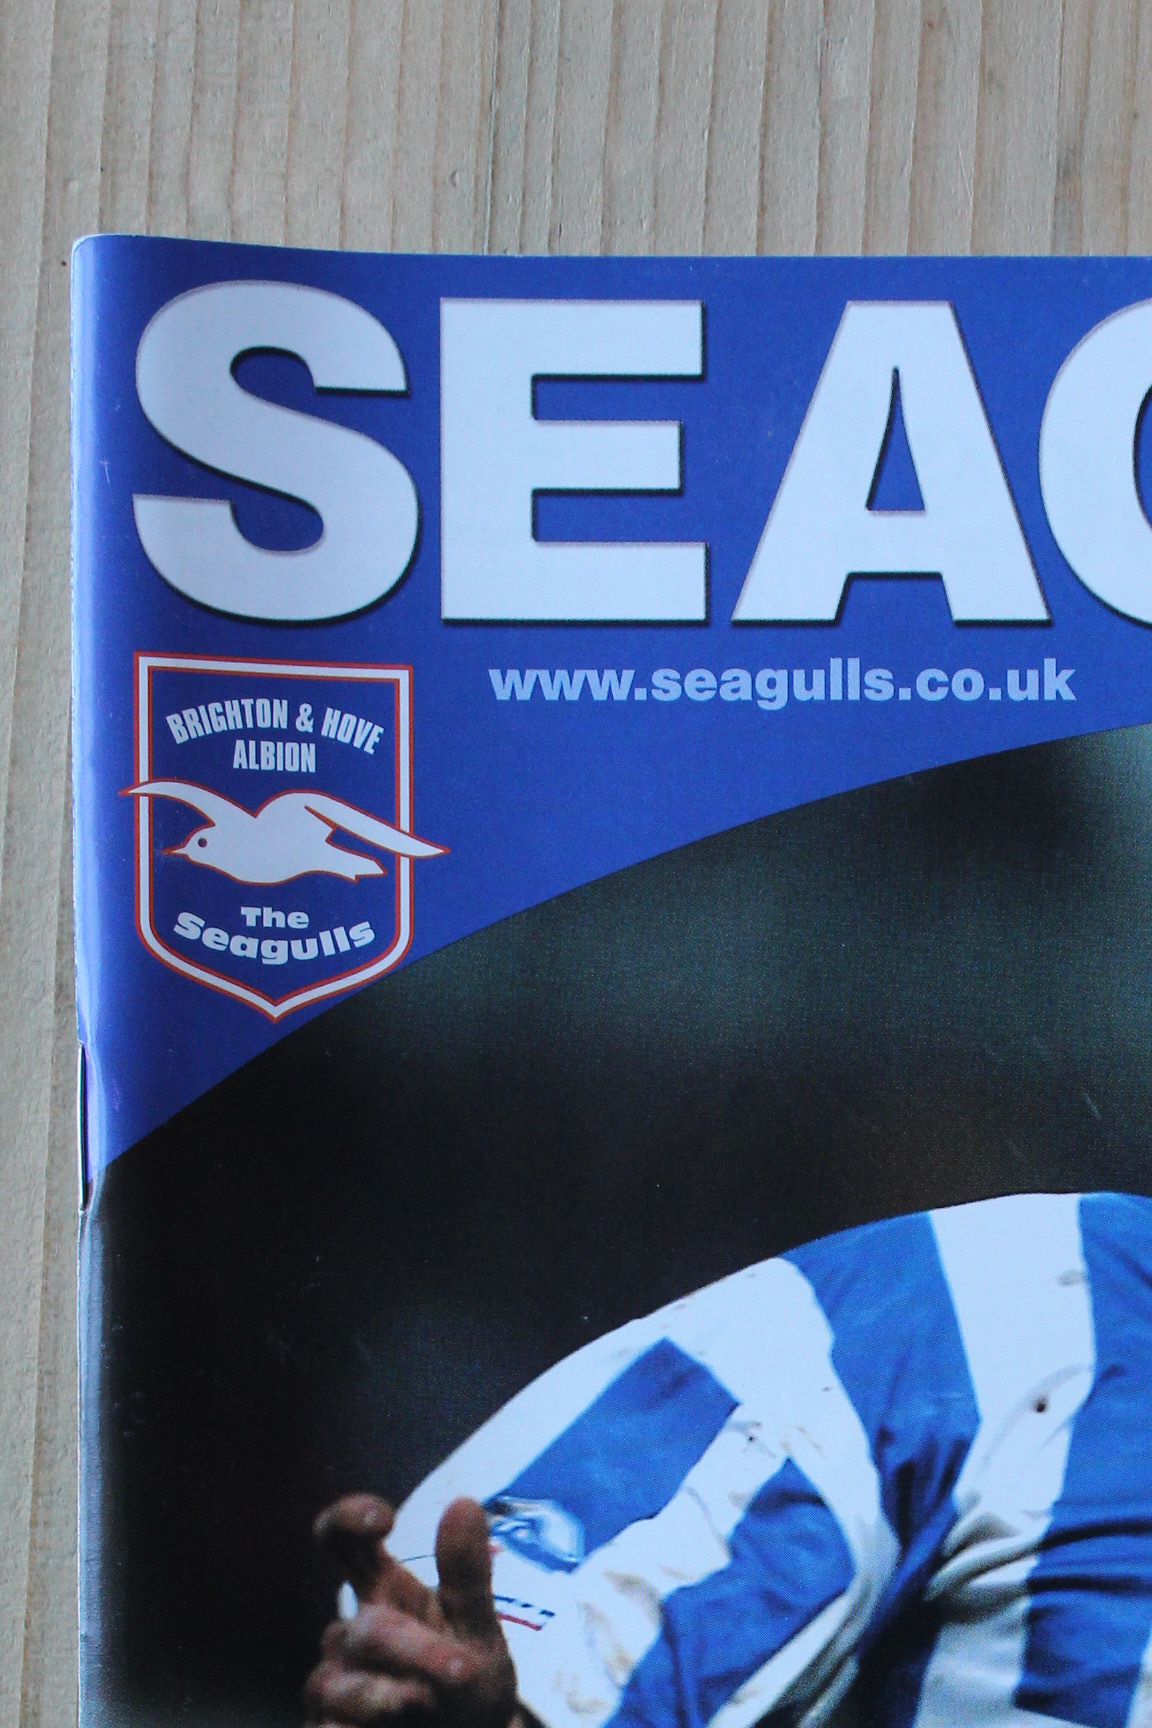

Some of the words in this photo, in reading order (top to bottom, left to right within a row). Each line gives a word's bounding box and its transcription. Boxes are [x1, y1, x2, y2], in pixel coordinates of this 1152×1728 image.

[487, 657, 1077, 711] www.seagulls.co.uk
[166, 698, 288, 744] BRIGHTON
[295, 703, 314, 733] &
[321, 707, 384, 755] HOVE
[233, 739, 316, 773] ALBION
[173, 911, 375, 965] Seagulls
[240, 906, 309, 930] The
